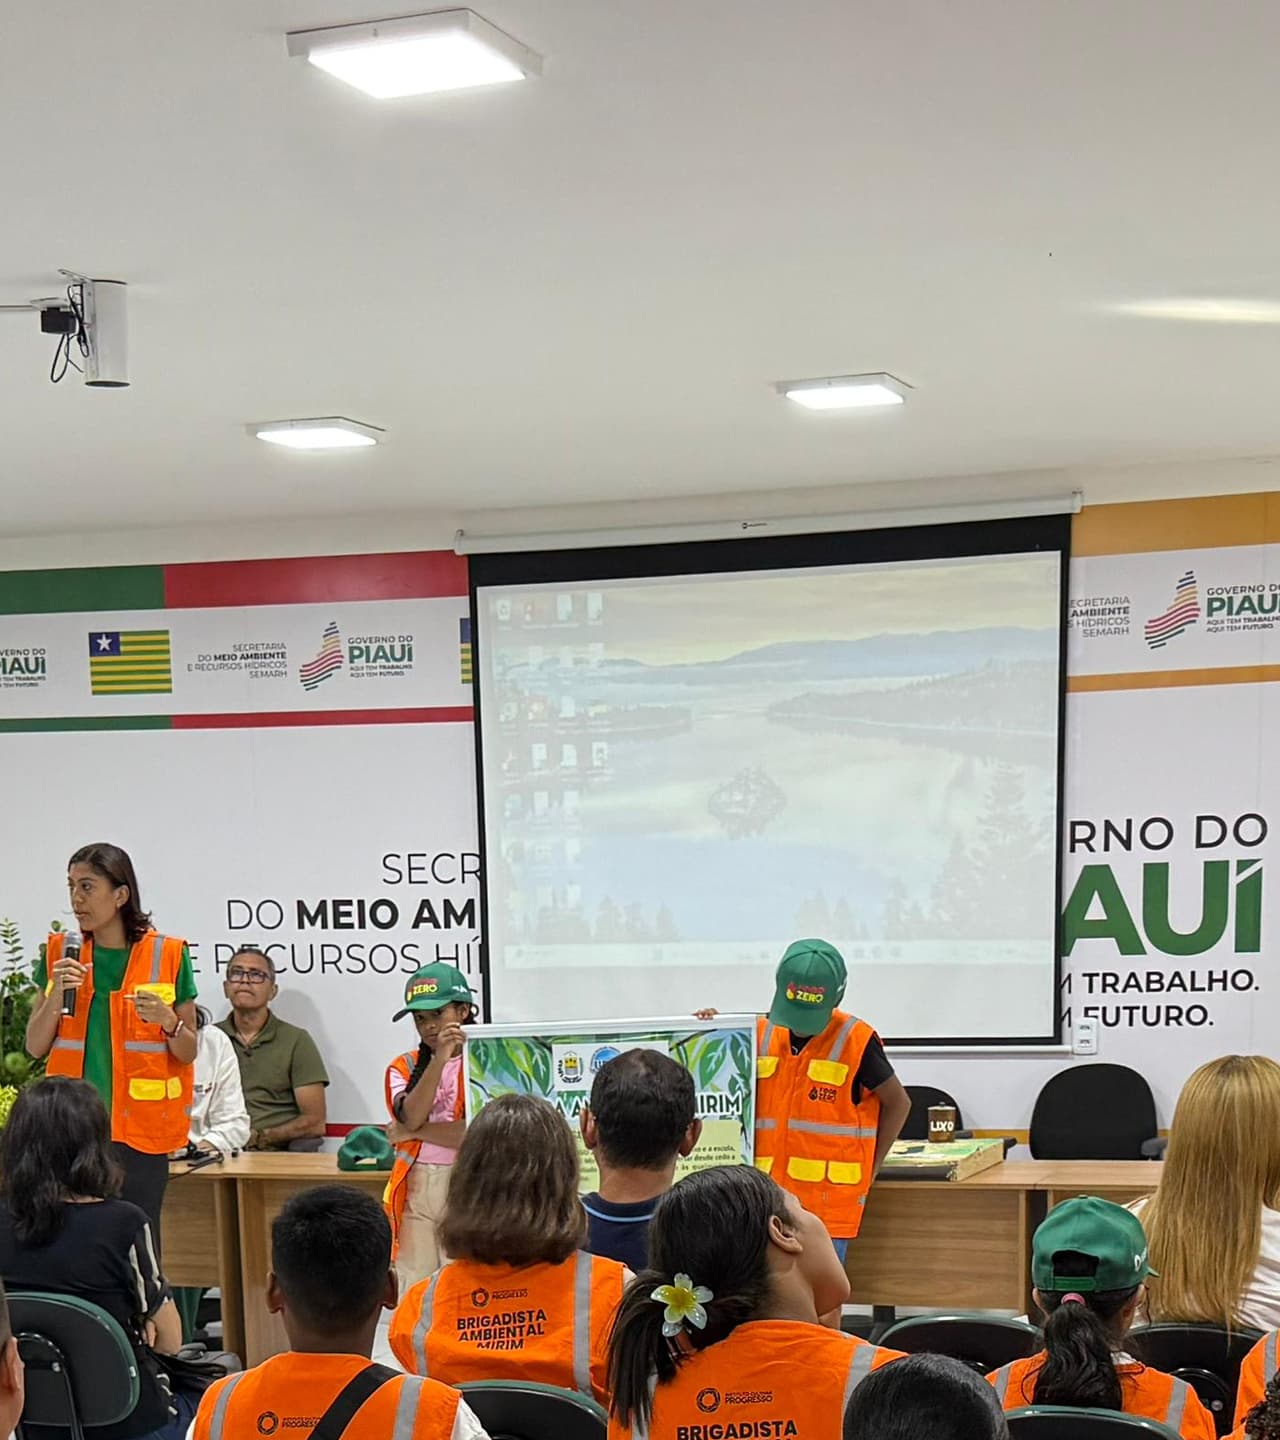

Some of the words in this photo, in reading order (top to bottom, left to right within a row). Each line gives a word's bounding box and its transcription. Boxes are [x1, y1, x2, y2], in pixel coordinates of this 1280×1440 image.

[1207, 584, 1266, 596] GOVERNO
[1070, 596, 1131, 608] ECRETARIA
[1071, 606, 1130, 618] AMBIENTE
[1076, 616, 1130, 628] HÍDRICOS
[1082, 627, 1130, 637] SEMARH
[348, 636, 395, 644] GOVERNO
[233, 642, 287, 652] SECRETARIA
[198, 654, 212, 662] DO
[214, 653, 238, 661] MEIO
[240, 651, 287, 660] AMBIENTE
[348, 644, 413, 664] PIAUÍ
[195, 662, 242, 671] RECURSOS
[249, 670, 287, 679] SEMARH
[1069, 816, 1174, 853] RNO
[1195, 813, 1268, 849] DO
[382, 853, 481, 885] SECR
[1061, 858, 1263, 957] AUÍ
[227, 899, 284, 930] DO
[296, 898, 400, 930] MEIO
[411, 898, 476, 930] AM
[215, 943, 420, 975] RCURSOS
[1082, 969, 1260, 994] TRABALHO.
[413, 984, 438, 995] ZERO
[796, 991, 824, 1003] ZERO
[1083, 1004, 1214, 1028] FUTURO.
[695, 1092, 742, 1115] IRIM
[930, 1120, 955, 1132] LIXO
[457, 1308, 547, 1330] BRIGADISTA
[458, 1323, 545, 1341] AMBIENTAL
[477, 1339, 524, 1350] MIRIM
[725, 1395, 773, 1404] PROGRESSO
